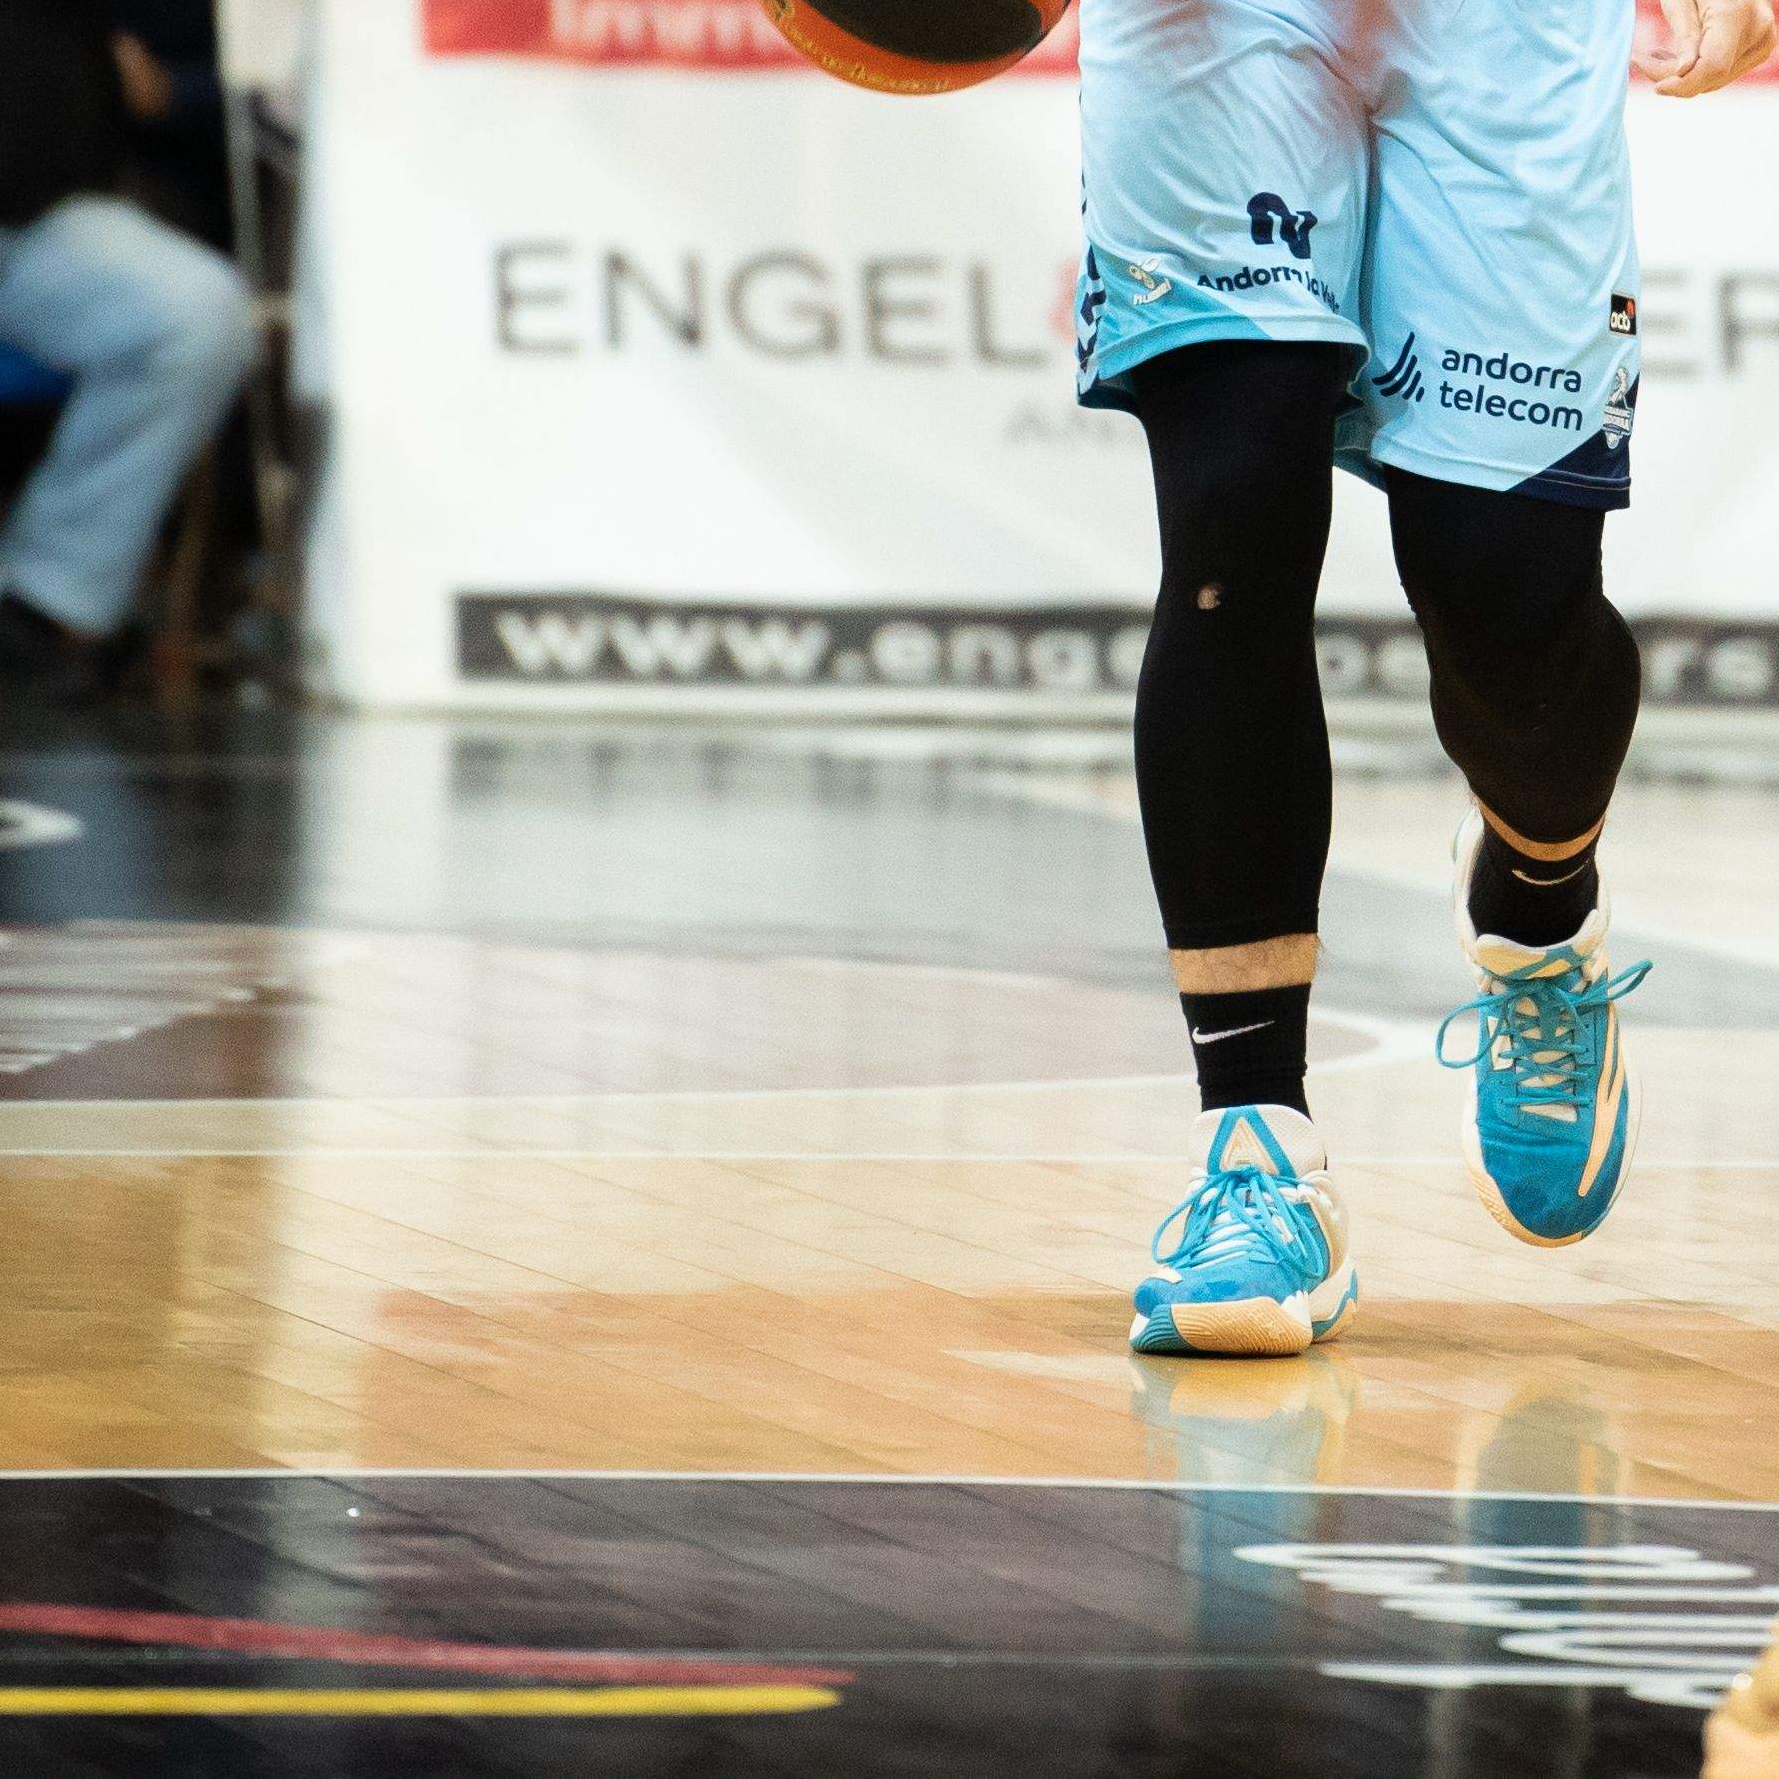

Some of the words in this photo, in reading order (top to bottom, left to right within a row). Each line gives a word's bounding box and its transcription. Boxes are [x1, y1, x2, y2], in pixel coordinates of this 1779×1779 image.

[490, 234, 1054, 369] ENGEL
[1610, 310, 1631, 334] acb
[1441, 348, 1583, 393] andorra
[1438, 380, 1584, 432] telecom
